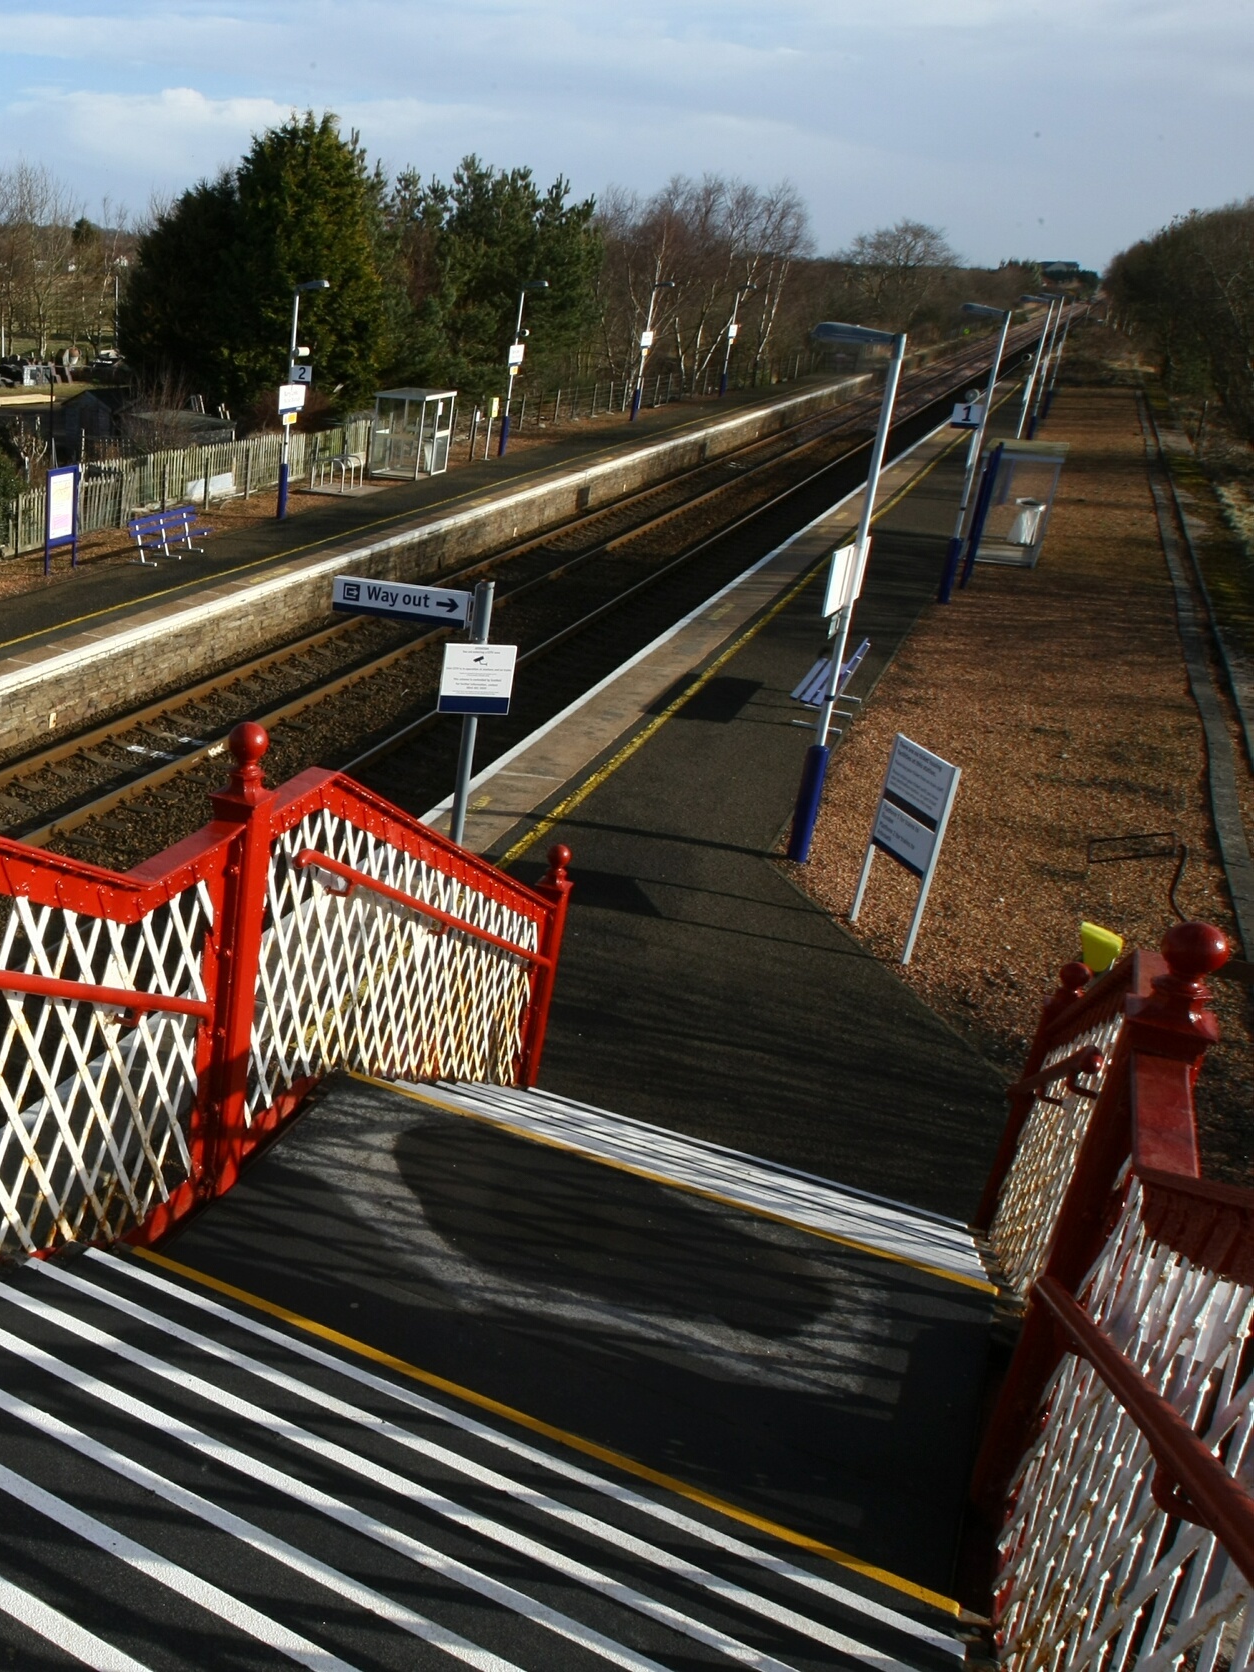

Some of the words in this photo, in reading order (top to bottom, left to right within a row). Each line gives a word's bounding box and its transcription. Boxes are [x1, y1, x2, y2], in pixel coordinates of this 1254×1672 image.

[298, 366, 306, 380] 2
[961, 405, 972, 422] 1
[367, 585, 399, 608] Way
[402, 592, 431, 608] out
